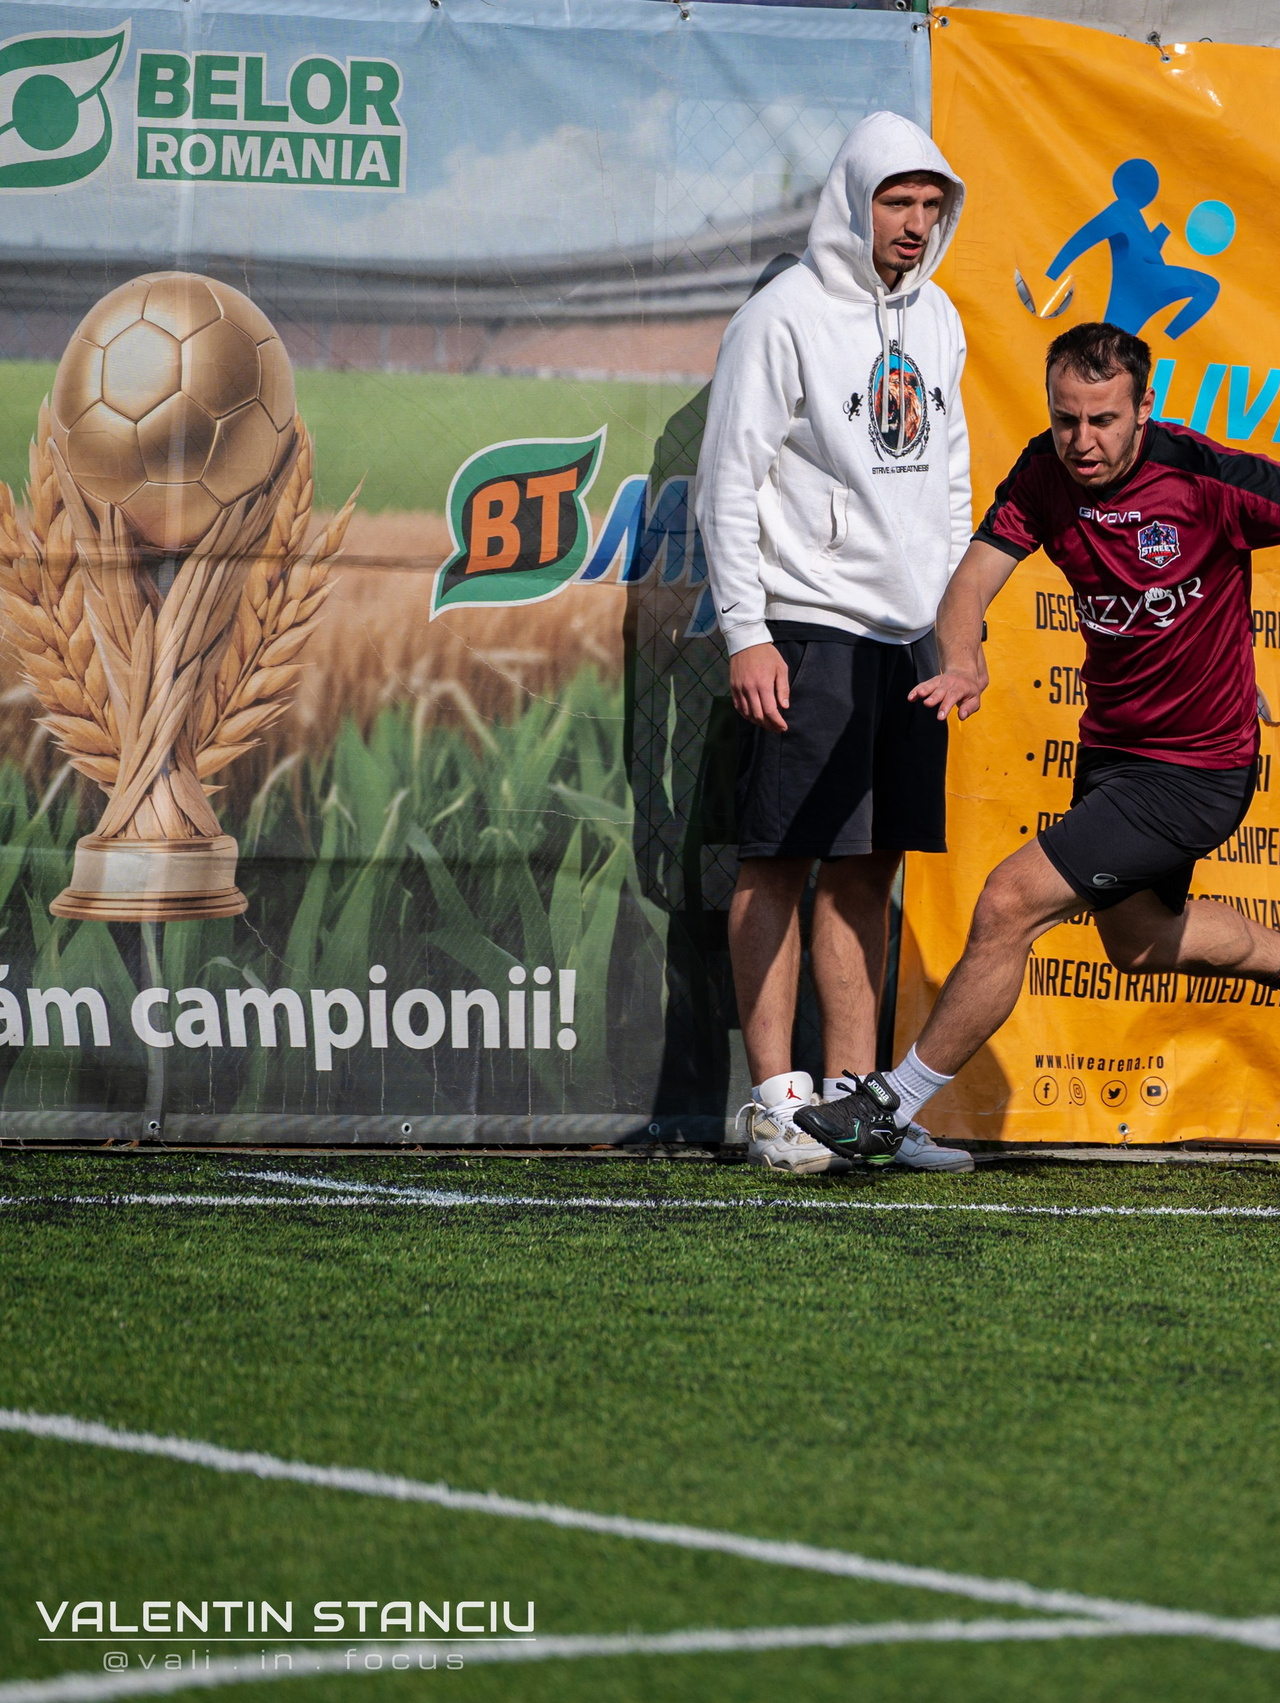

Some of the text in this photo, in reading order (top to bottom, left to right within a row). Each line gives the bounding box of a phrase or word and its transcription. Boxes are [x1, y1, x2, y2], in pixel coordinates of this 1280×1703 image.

[137, 53, 401, 126] BELOR
[145, 133, 391, 181] ROMANIA
[465, 467, 578, 575] BT
[1079, 506, 1141, 523] GIVOVA
[1141, 544, 1176, 557] STREET
[131, 964, 578, 1072] campionii!
[1035, 1053, 1164, 1073] www.livearena.ro
